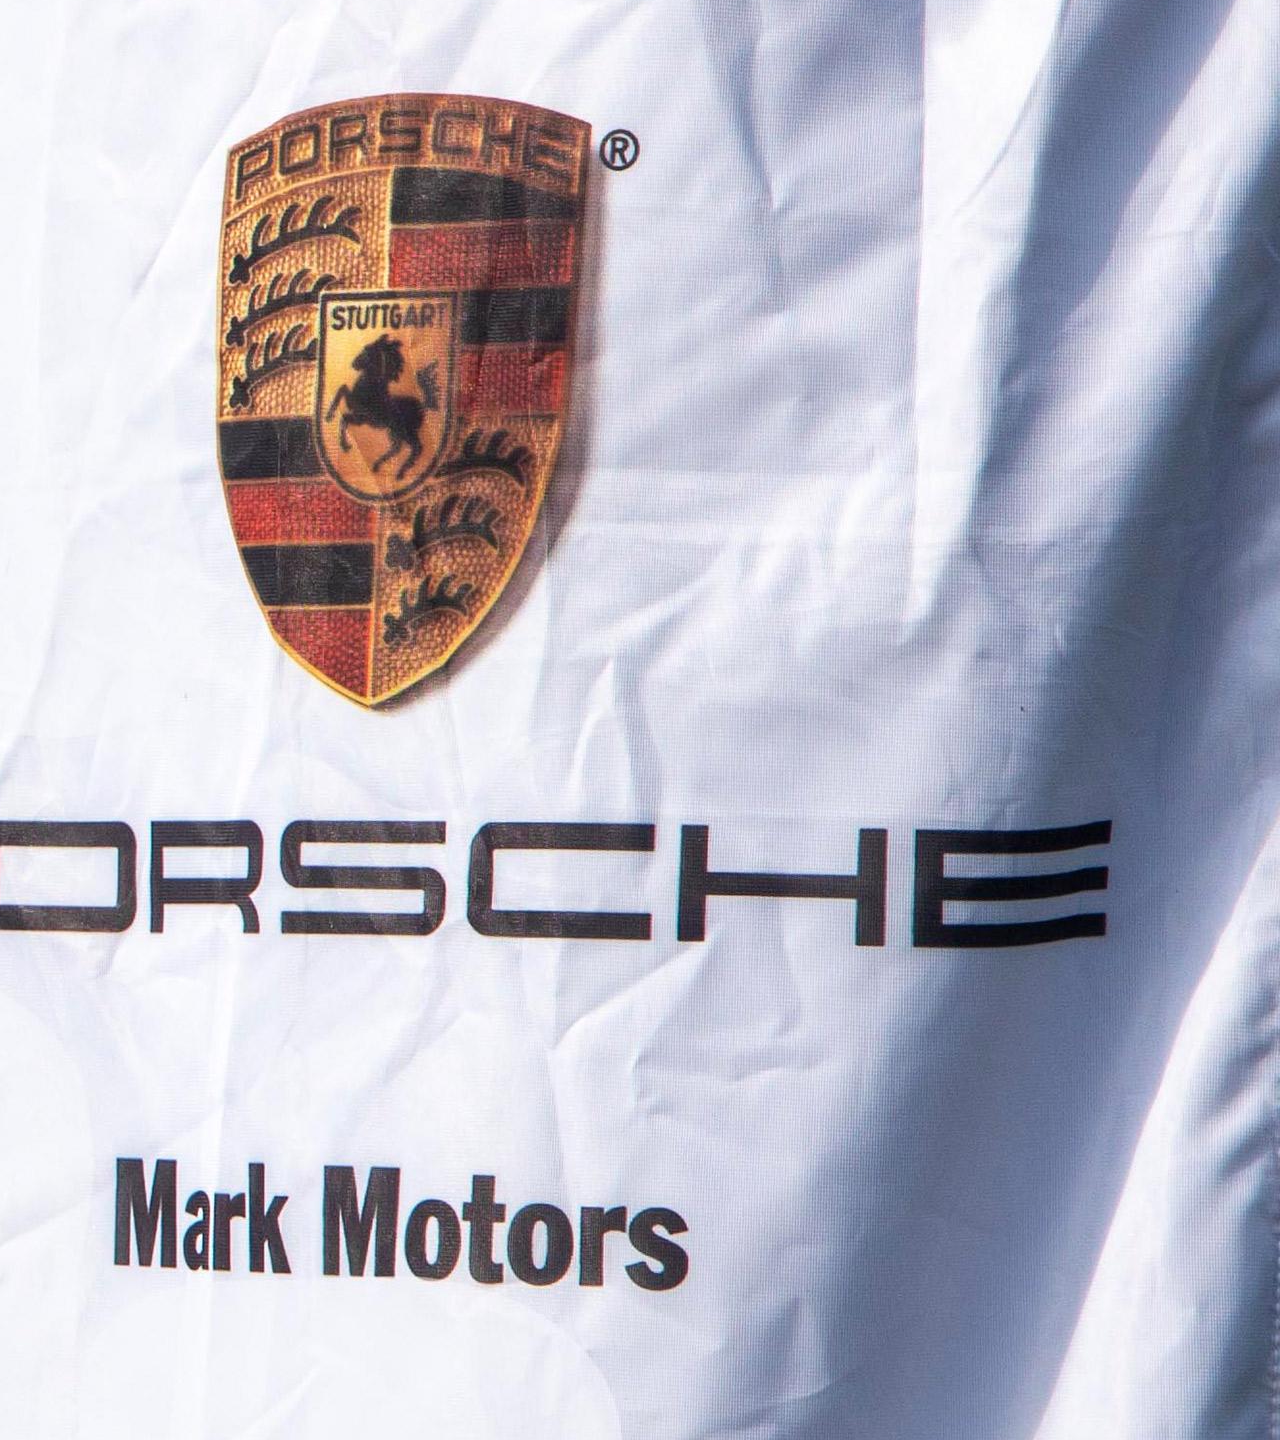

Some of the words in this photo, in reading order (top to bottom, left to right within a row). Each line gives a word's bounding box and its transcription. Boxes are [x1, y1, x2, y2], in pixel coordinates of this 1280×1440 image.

[234, 108, 574, 202] PORSCHE
[329, 300, 449, 332] STUTTGART
[113, 1156, 292, 1275] Mark
[322, 1163, 690, 1292] Motors
